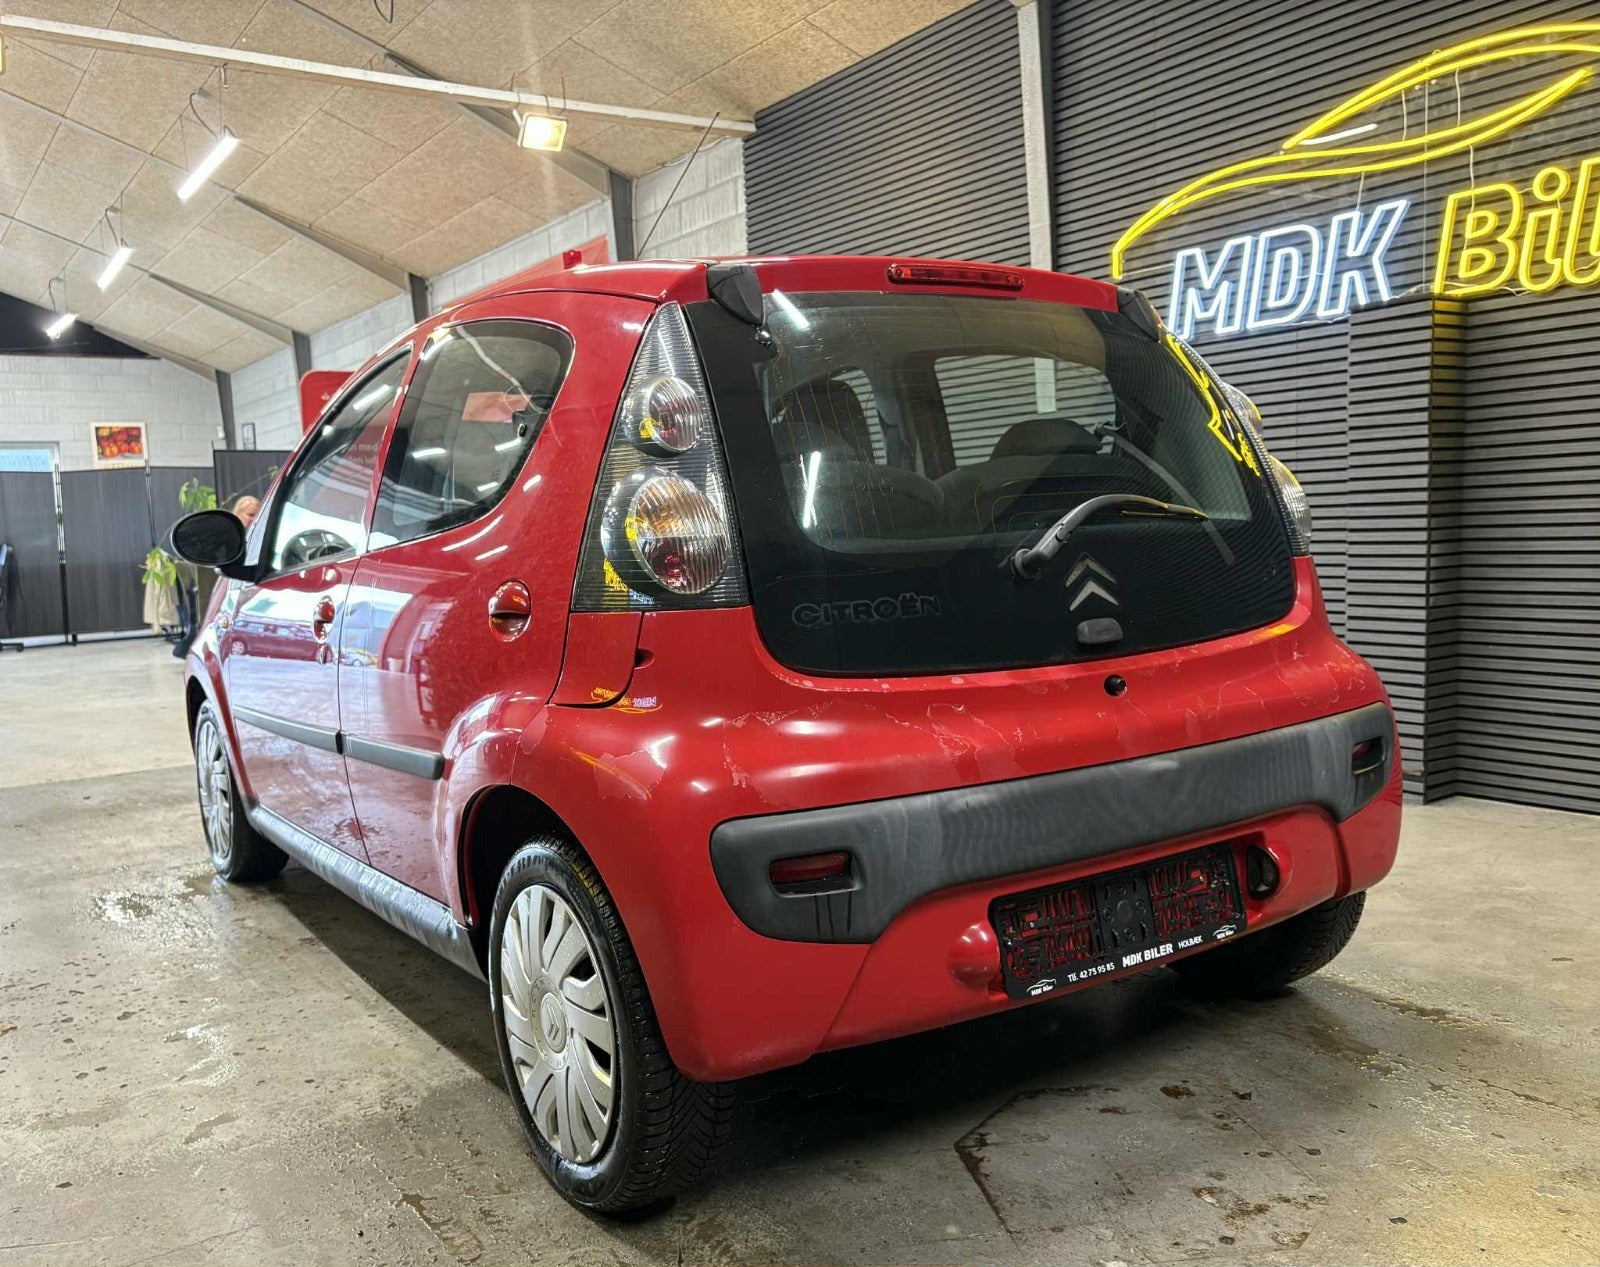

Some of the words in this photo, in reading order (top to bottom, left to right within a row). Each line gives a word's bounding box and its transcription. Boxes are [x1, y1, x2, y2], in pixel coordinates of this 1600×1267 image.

[1165, 198, 1411, 340] MDK
[1434, 157, 1600, 296] Bil
[791, 591, 942, 628] CITROËN
[1079, 970, 1088, 979] 42
[1121, 950, 1143, 968] MDK
[1144, 943, 1173, 960] BILER
